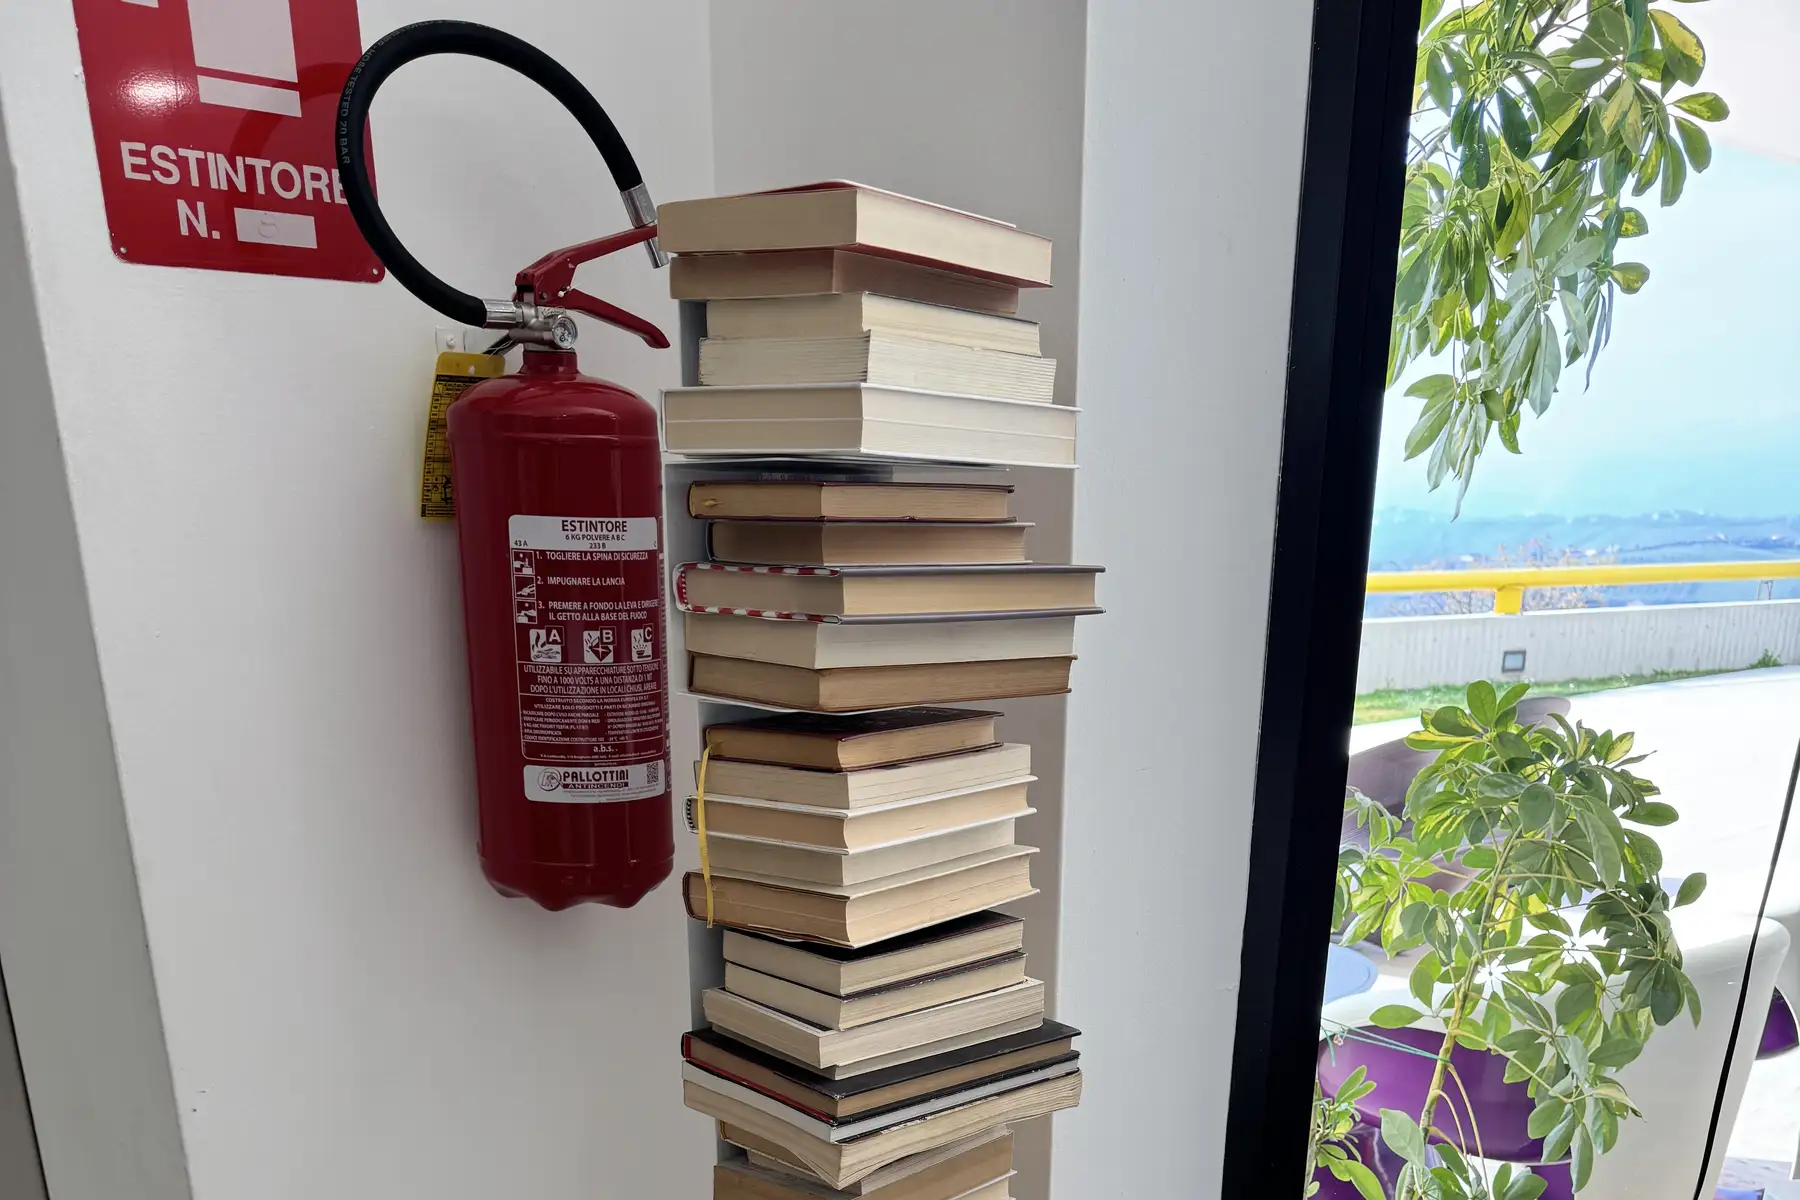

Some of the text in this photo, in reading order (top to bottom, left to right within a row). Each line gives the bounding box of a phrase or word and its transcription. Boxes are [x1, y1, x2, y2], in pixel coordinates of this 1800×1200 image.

[353, 47, 376, 73] HOSE
[340, 73, 360, 117] TESTED
[339, 120, 348, 134] 20
[339, 138, 351, 164] BAR
[119, 139, 348, 205] ESTINTORE
[176, 198, 221, 240] N.
[561, 520, 628, 533] ESTINTORE
[537, 552, 648, 561] 1. TOGLIERE LA SPINA DI SICUREZZA
[537, 577, 626, 586] 2. IMPUGNARE LA LANCIA
[538, 601, 545, 609] 3.
[548, 601, 582, 610] PREMERE
[583, 601, 589, 610] A
[589, 601, 614, 610] FONDO
[614, 601, 623, 610] LA
[623, 600, 637, 609] LEVA
[638, 600, 642, 609] E
[549, 611, 648, 621] IL GETTO ALLA BASE DEL FUOCO
[548, 629, 562, 643] A
[602, 629, 614, 643] B
[644, 627, 652, 639] C
[523, 664, 563, 675] UTILIZZABILE
[564, 666, 573, 675] SU
[574, 665, 626, 675] APPARECCHIATURE
[626, 664, 642, 673] SOTTO
[537, 675, 552, 684] FINO
[553, 676, 558, 684] A
[559, 676, 574, 685] 1000
[574, 676, 594, 685] VOLTS
[594, 676, 600, 684] A
[600, 676, 613, 684] UNA
[613, 674, 638, 684] DISTANZA
[530, 684, 548, 694] DOPO
[549, 685, 599, 694] L'UTILIZZAZIONE
[600, 686, 606, 694] IN
[606, 684, 626, 694] LOCALI
[562, 769, 628, 782] PALLOTTINI
[568, 782, 626, 790] ANTINCENDI
